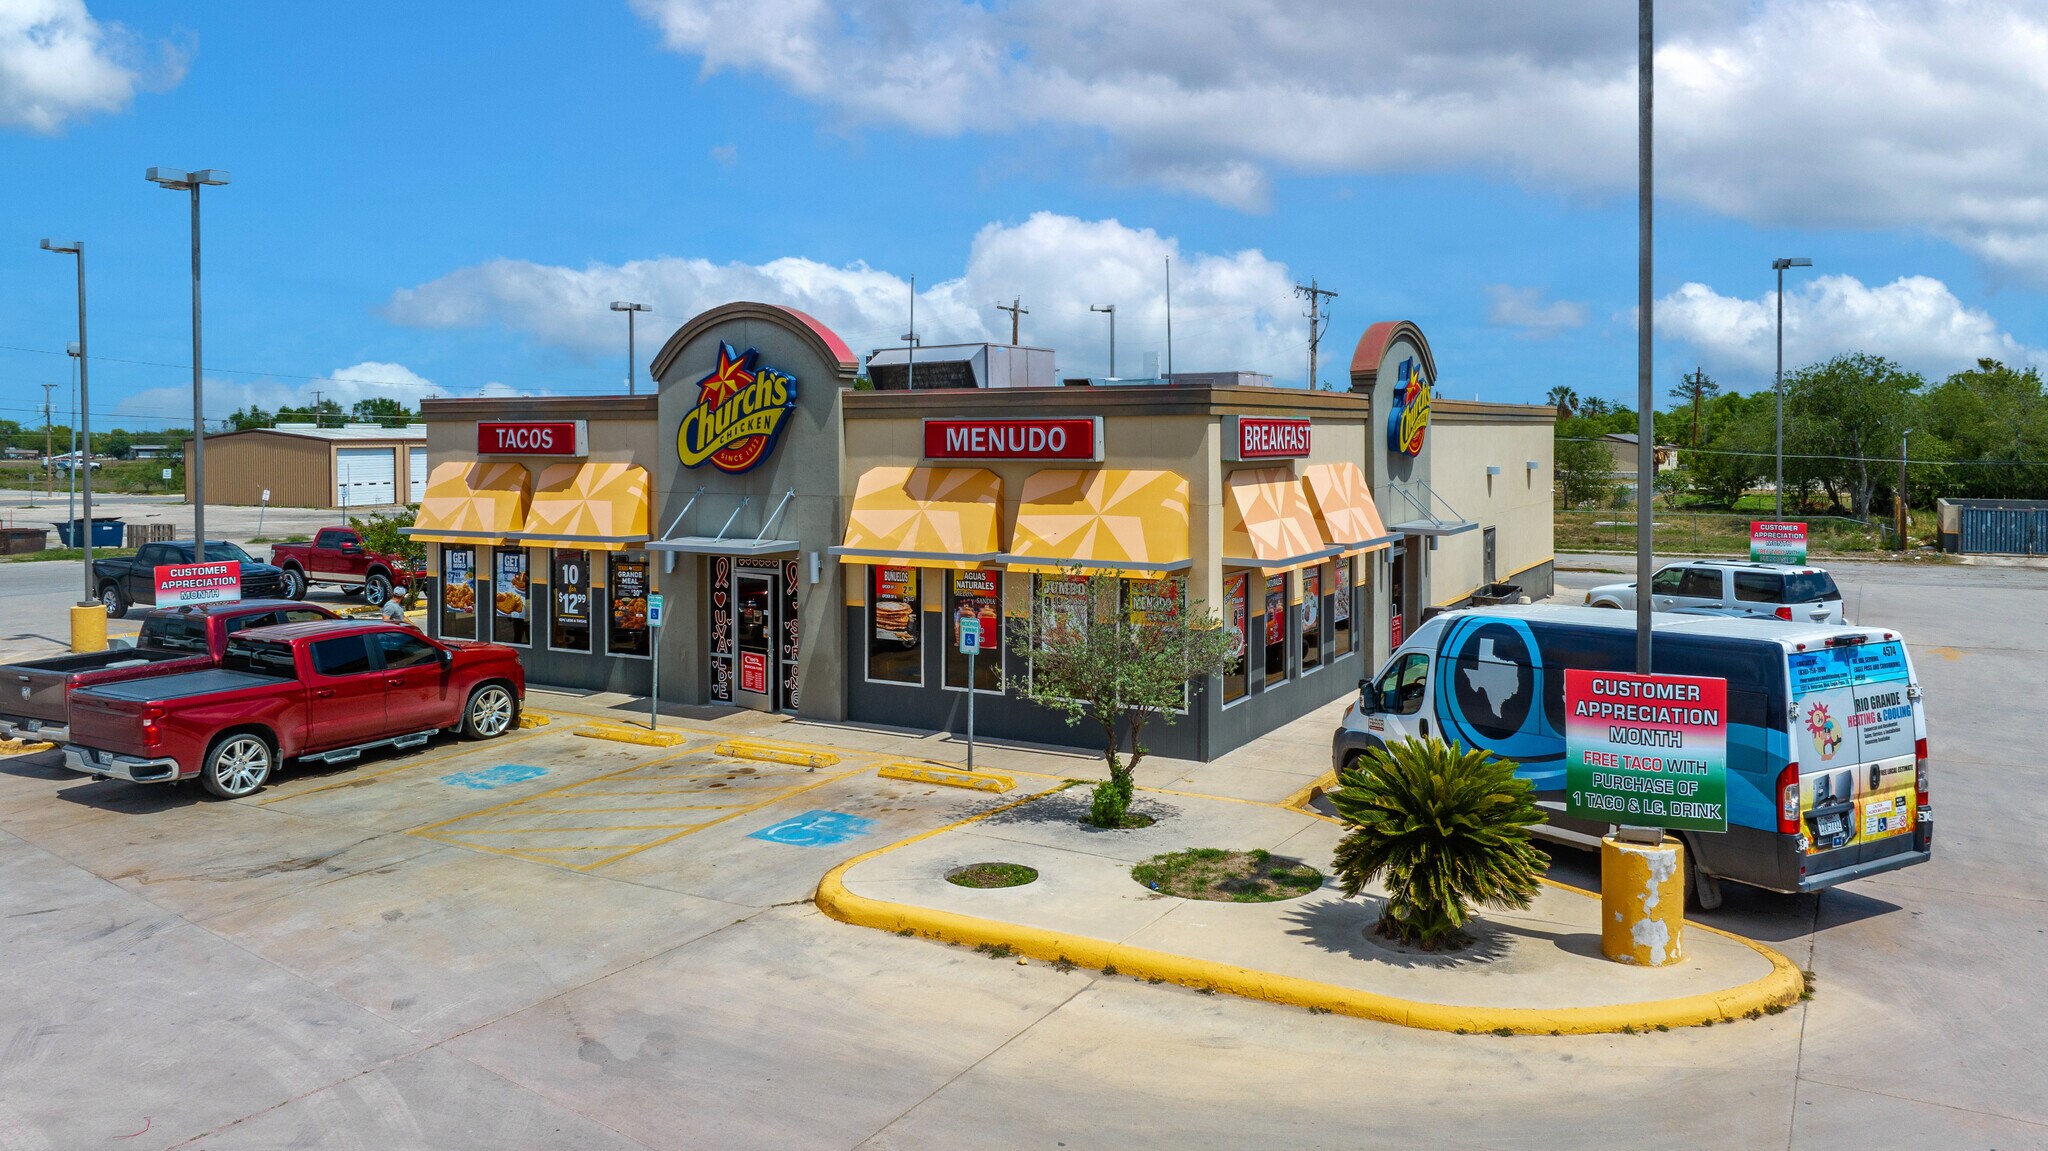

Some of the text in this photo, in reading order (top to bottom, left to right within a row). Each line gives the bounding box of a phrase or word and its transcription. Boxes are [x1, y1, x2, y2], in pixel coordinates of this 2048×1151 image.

[677, 371, 787, 466] Church's
[720, 415, 772, 444] CHICKEN
[496, 428, 553, 449] TACOS
[946, 427, 1066, 452] MENUDO
[1244, 426, 1310, 450] BREAKFAST
[720, 438, 759, 462] SINCE 1952
[452, 552, 466, 563] GET
[504, 555, 518, 566] GET
[170, 566, 227, 577] CUSTOMER
[562, 564, 578, 584] 10
[964, 571, 986, 580] AGUAS
[161, 577, 236, 589] APPRECIATION
[956, 580, 994, 590] NATURALES
[181, 590, 219, 600] MONTH
[1882, 646, 1896, 657] 4574
[1592, 678, 1700, 701] CUSTOMER
[1574, 700, 1718, 726] APPRECIATION
[1856, 692, 1900, 712] RIO GRANDE
[1847, 705, 1911, 728] HEATING & COOLING
[1609, 726, 1682, 748] MONTH
[1584, 751, 1708, 775] FREE TACO WITH
[1593, 772, 1698, 796] PURCHASE OF
[1572, 791, 1722, 819] 1 TACO & LG. DRINK
